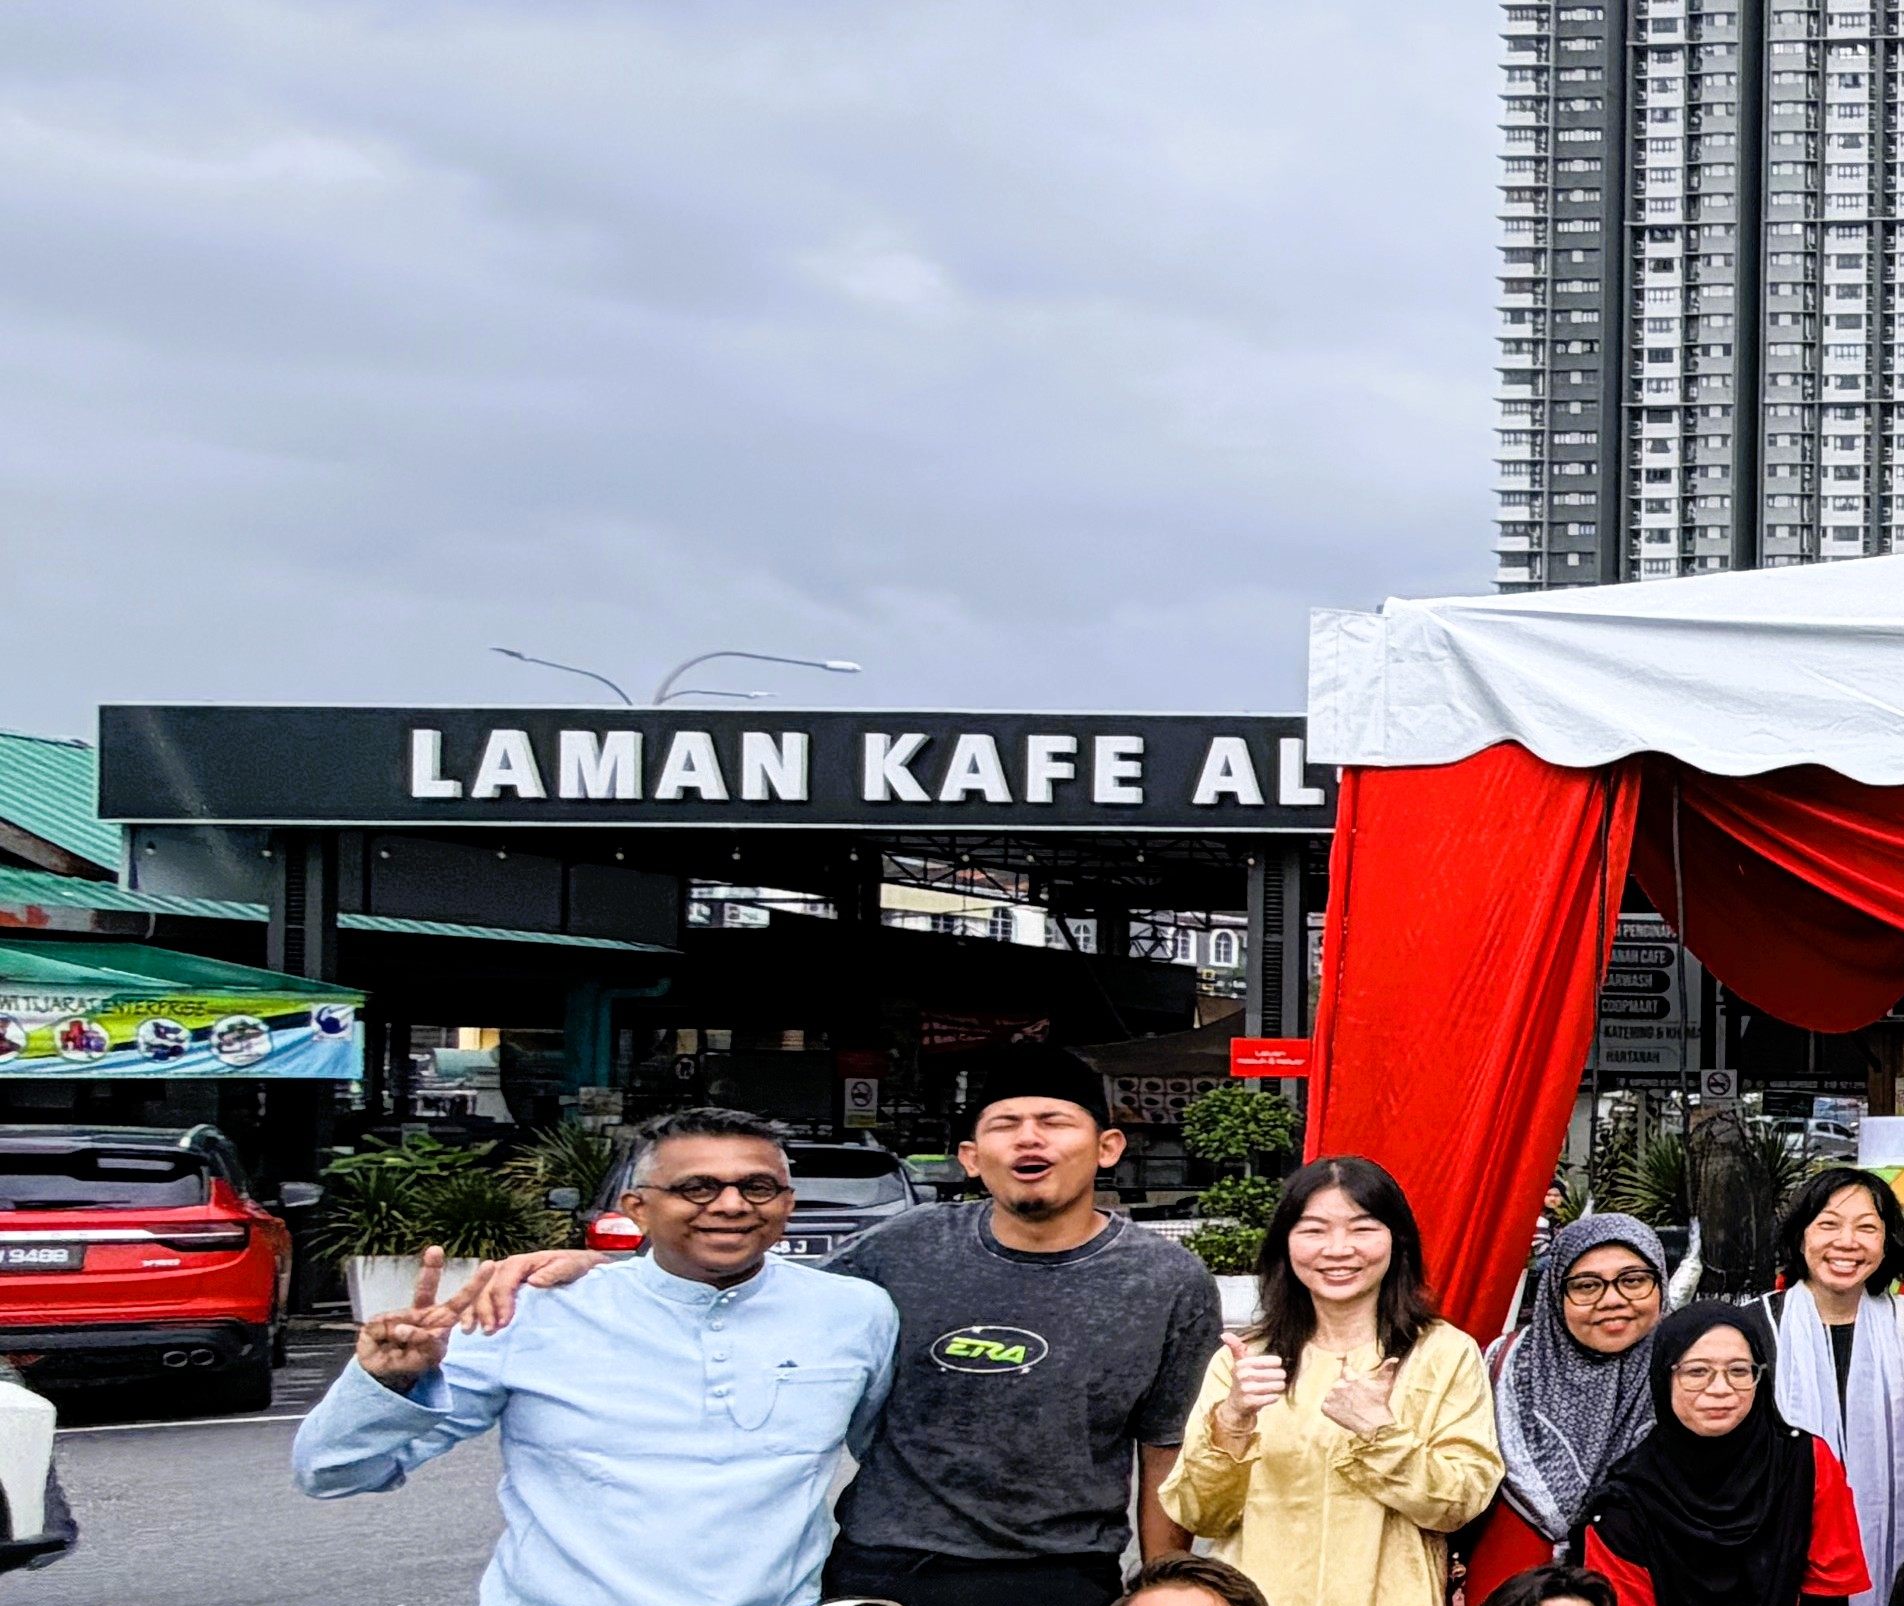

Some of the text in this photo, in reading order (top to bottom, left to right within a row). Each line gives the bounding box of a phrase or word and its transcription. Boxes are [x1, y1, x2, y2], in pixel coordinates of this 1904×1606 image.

[411, 728, 809, 801] LAMAN
[863, 732, 1144, 804] KAFE
[945, 1336, 1026, 1365] ERA
